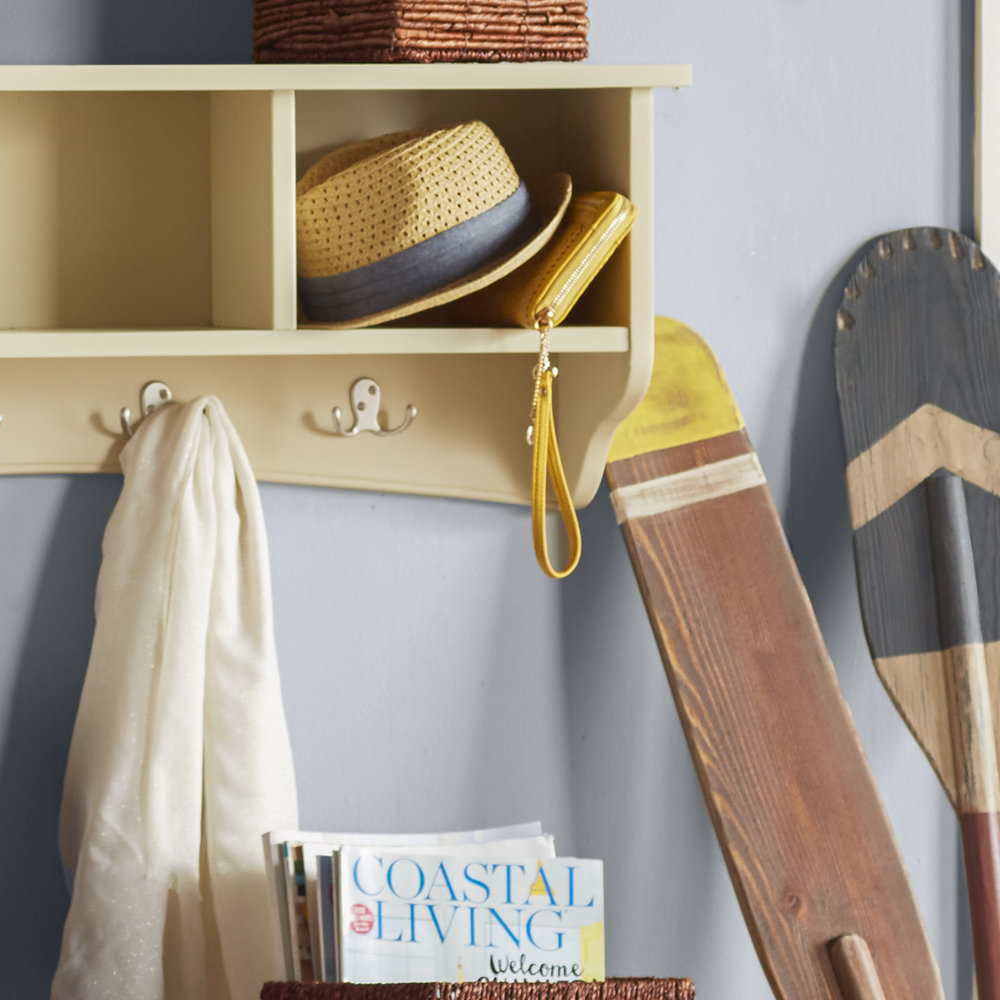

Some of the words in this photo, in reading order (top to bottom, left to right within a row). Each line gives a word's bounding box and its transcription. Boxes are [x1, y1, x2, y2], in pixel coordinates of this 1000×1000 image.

[353, 855, 594, 907] COASTAL
[373, 900, 566, 952] LIVING
[489, 953, 585, 978] Welcome
